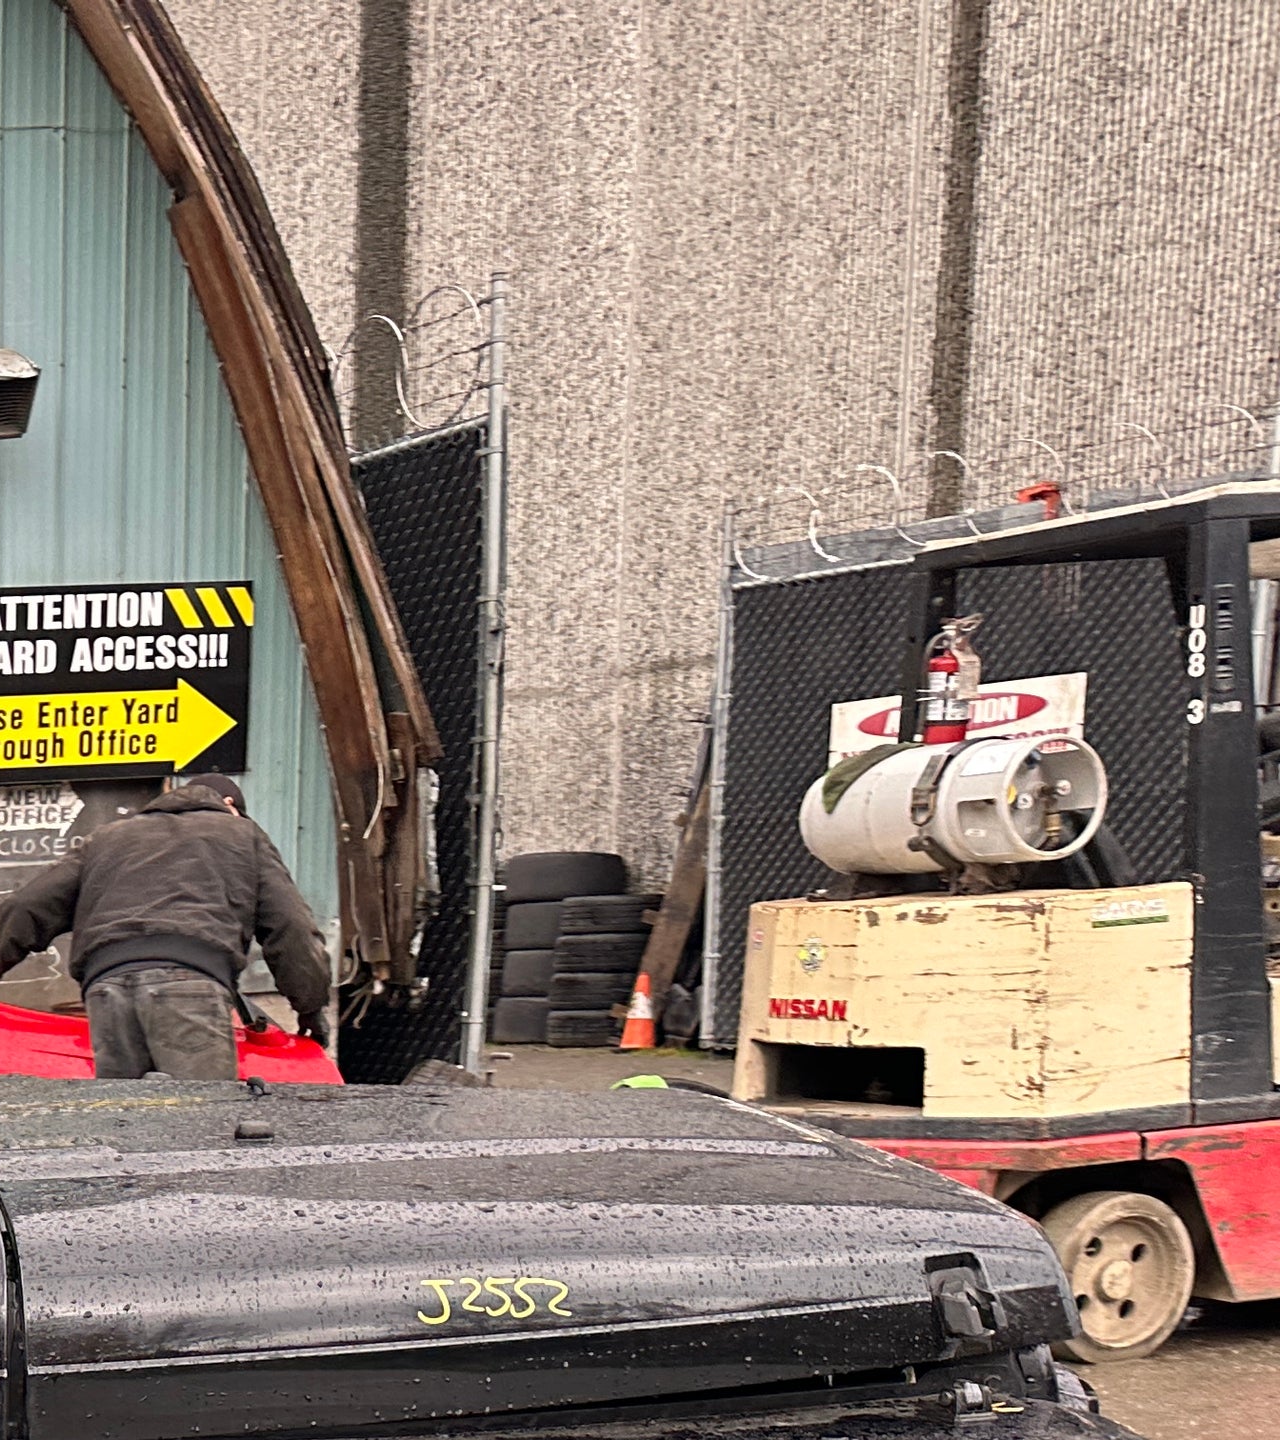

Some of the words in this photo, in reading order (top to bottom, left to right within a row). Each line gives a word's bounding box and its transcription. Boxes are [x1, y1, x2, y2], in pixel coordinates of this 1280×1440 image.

[69, 633, 229, 673] ACCESS!!!
[37, 701, 109, 728] Enter
[122, 697, 180, 724] Yard
[78, 728, 158, 757] Office
[8, 786, 59, 806] NEW
[768, 997, 848, 1022] NISSAN
[417, 1276, 572, 1325] J2552
